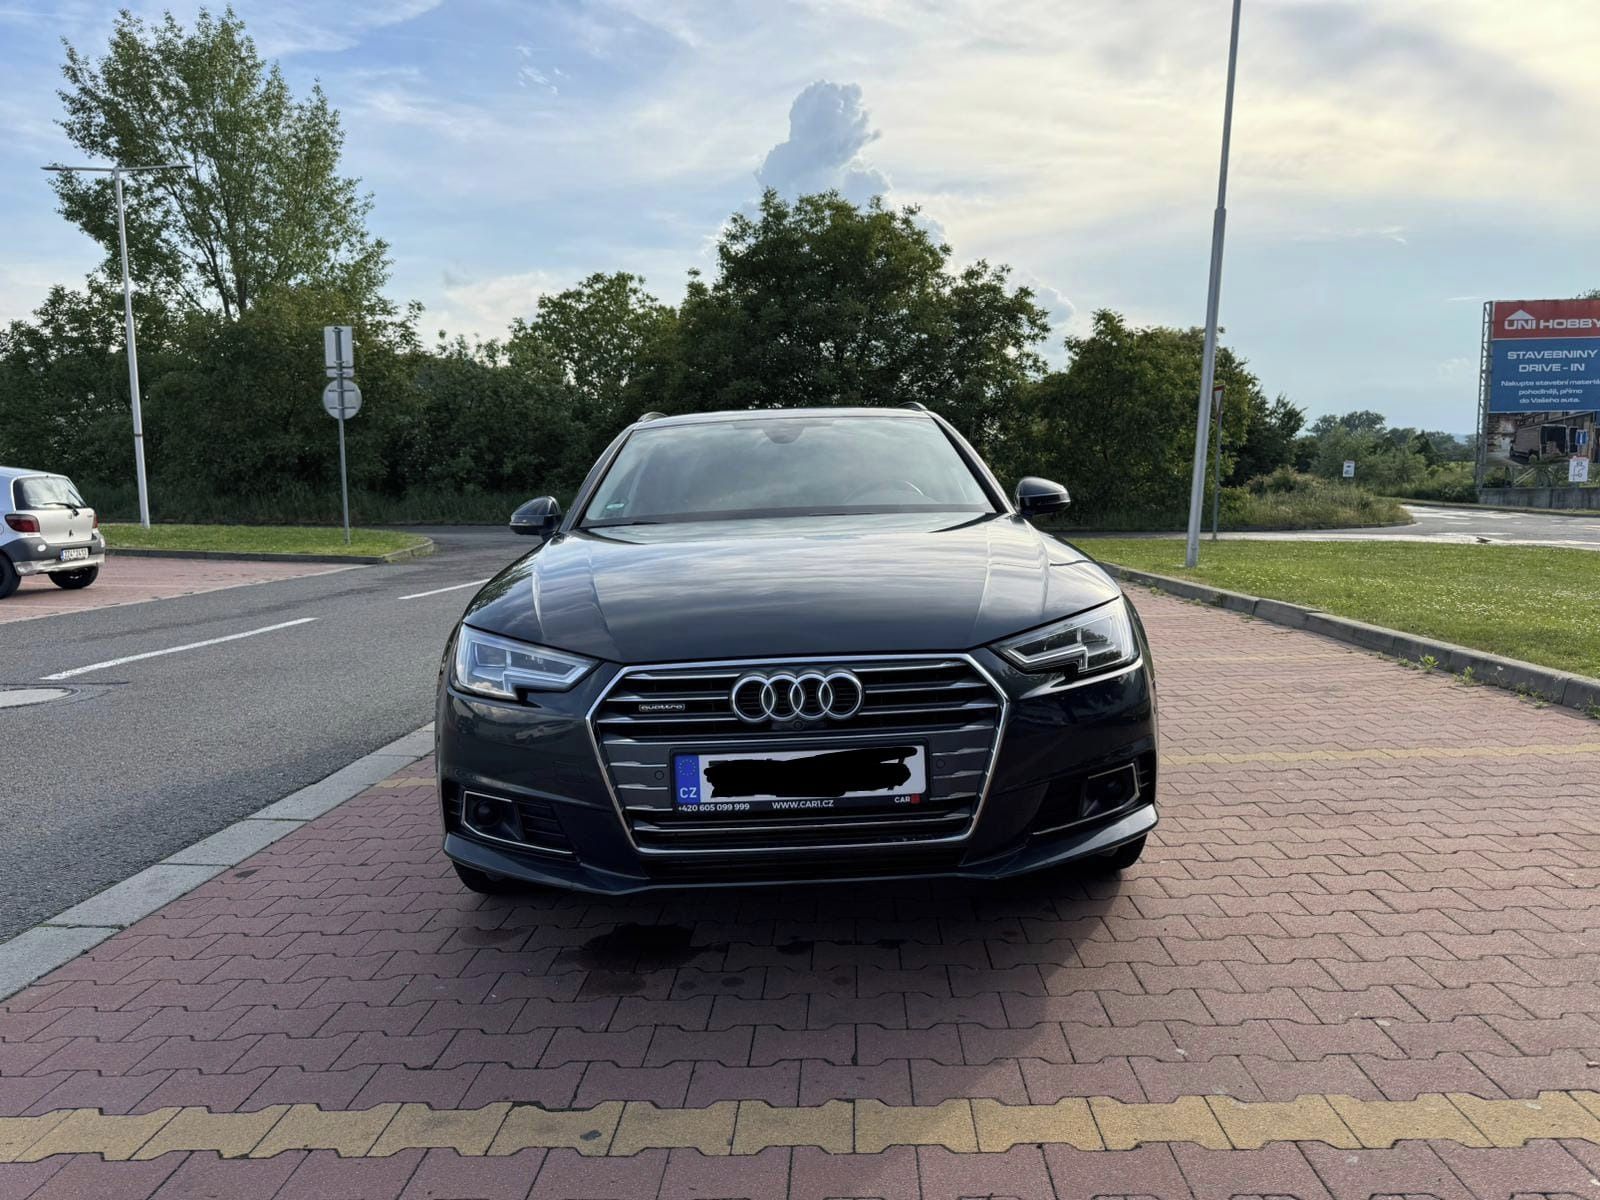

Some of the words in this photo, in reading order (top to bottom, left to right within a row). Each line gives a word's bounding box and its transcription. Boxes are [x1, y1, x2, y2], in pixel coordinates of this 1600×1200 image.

[1504, 319, 1536, 330] UNI
[1540, 318, 1600, 329] HOBBY
[1507, 349, 1598, 360] STAVEBNINY
[1518, 363, 1561, 373] DRIVE
[1570, 363, 1585, 372] IN
[680, 787, 697, 798] CZ
[678, 804, 698, 812] +420
[716, 803, 733, 811] 099
[771, 799, 834, 809] WWW.CAR1.CZ
